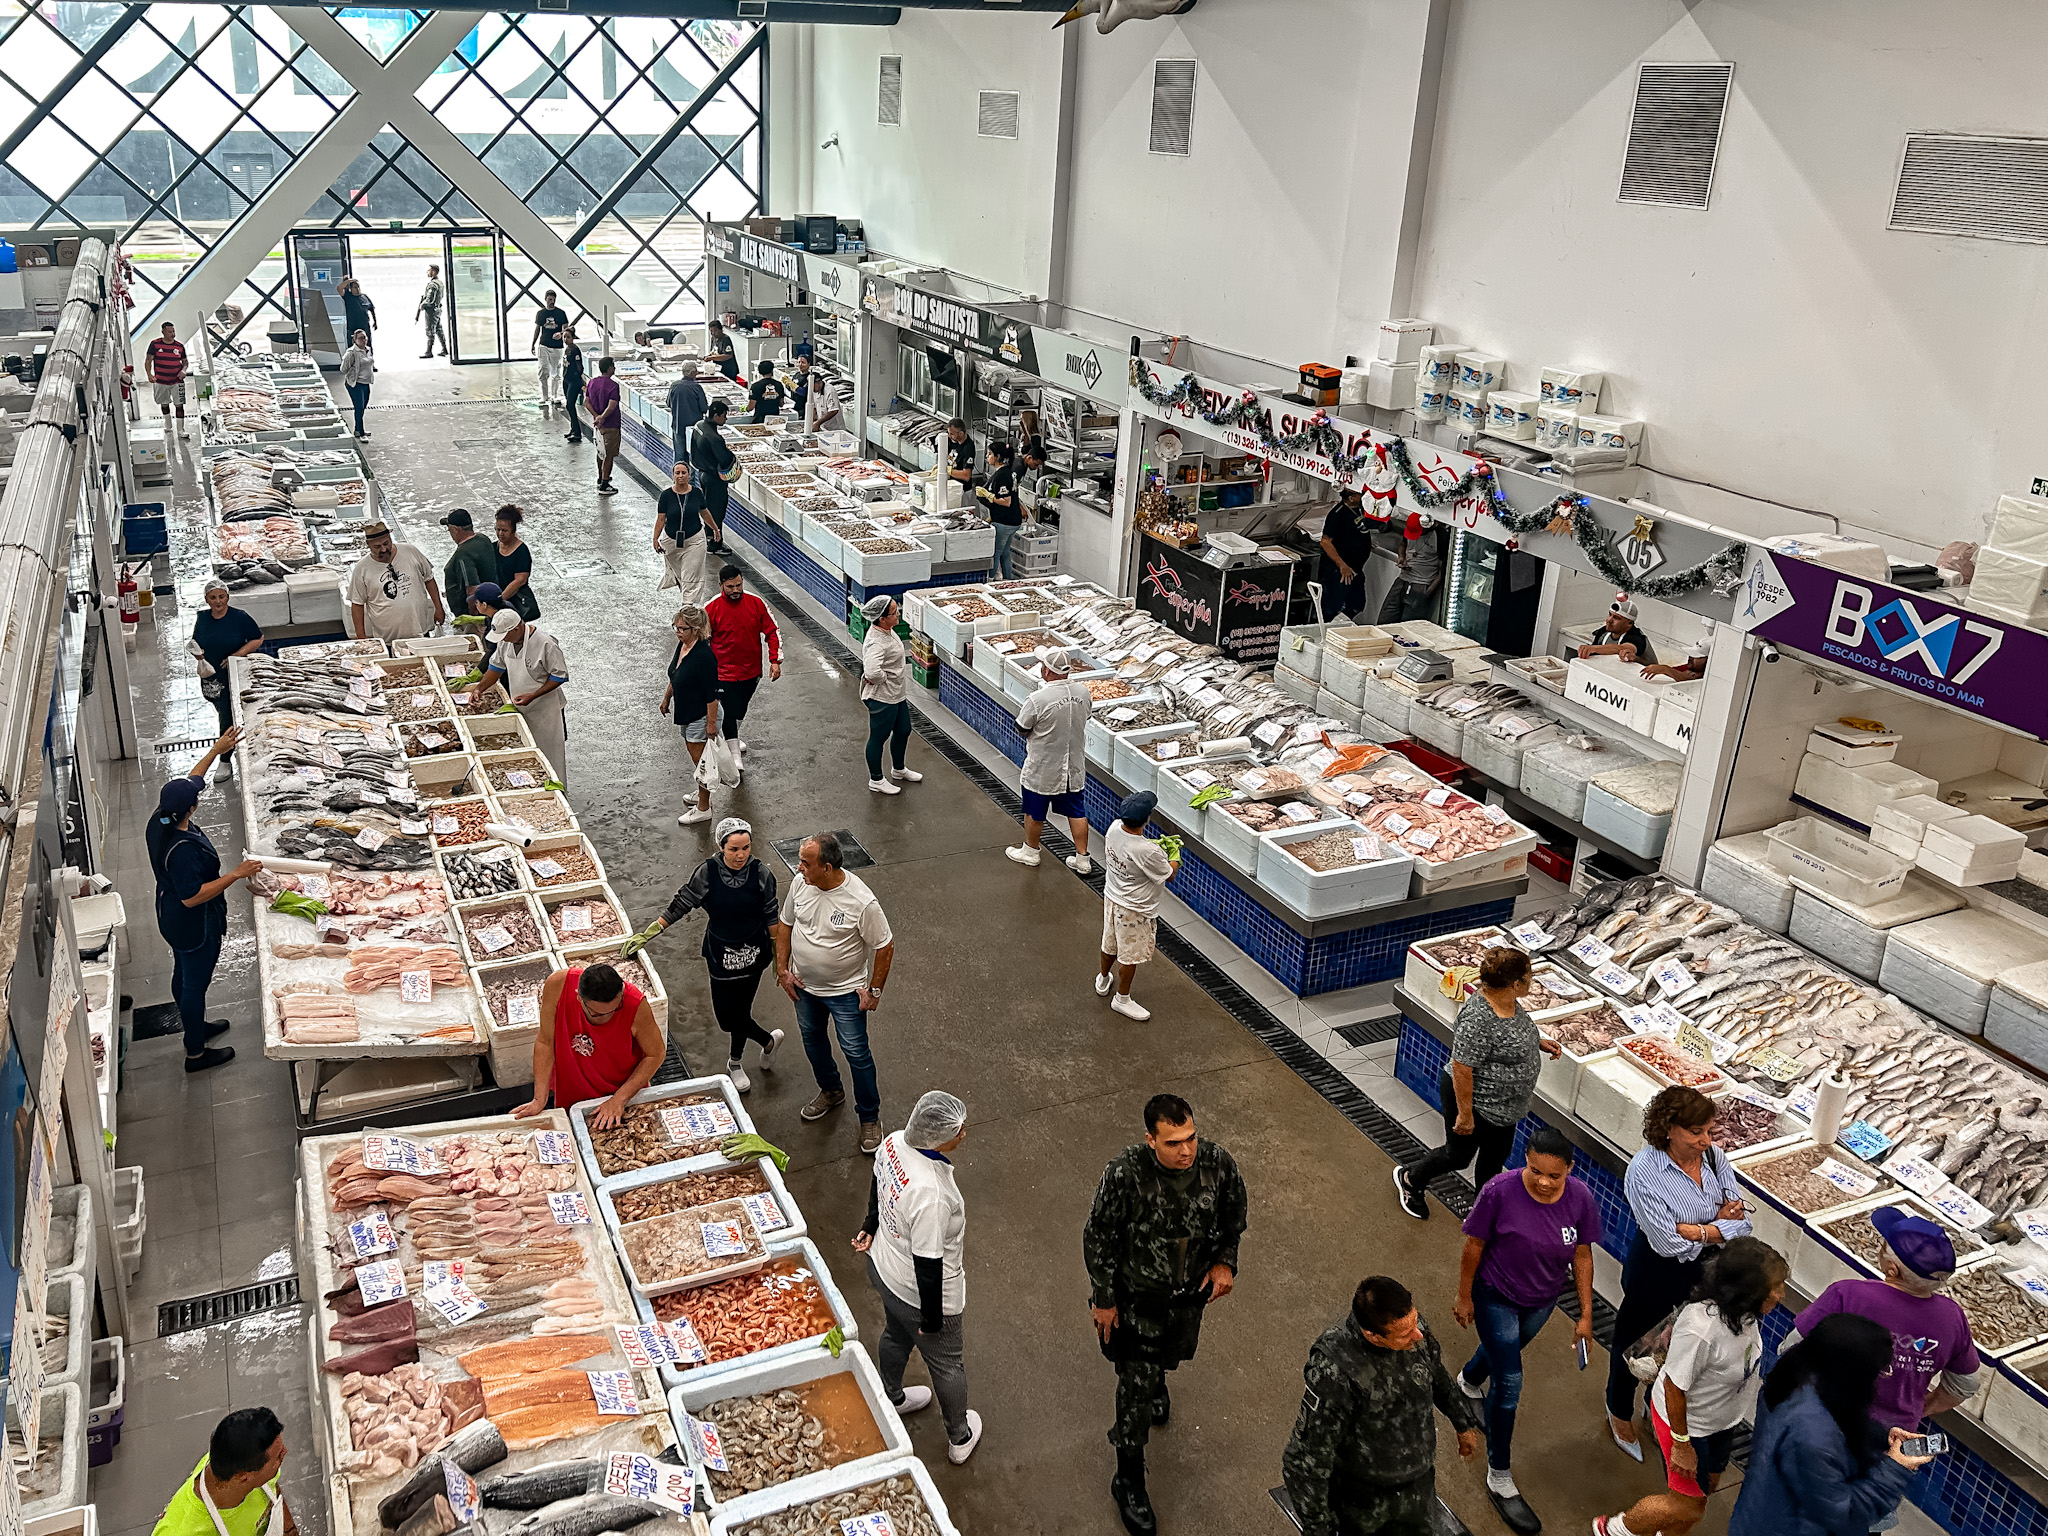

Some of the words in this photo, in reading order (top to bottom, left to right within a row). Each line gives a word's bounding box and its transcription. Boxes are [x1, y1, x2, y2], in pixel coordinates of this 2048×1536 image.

[740, 237, 758, 264] ALEX
[758, 242, 799, 282] SANTISTA
[821, 271, 831, 286] BOX
[894, 283, 913, 315] BOX
[914, 293, 928, 321] DO
[929, 298, 980, 339] SANTISTA
[1066, 353, 1082, 375] BOX
[1086, 360, 1096, 379] 03
[1227, 431, 1241, 446] (13)
[1290, 451, 1305, 469] (13)
[1627, 536, 1653, 569] 05
[1756, 589, 1778, 605] 1982
[1757, 581, 1785, 597] DESDE
[1822, 641, 1878, 673] PESCADOS
[1879, 660, 1889, 673] &
[1890, 666, 1936, 691] FRUTOS
[1937, 682, 1955, 697] DO
[1957, 689, 1985, 708] MAR
[666, 1110, 688, 1138] OFERTA
[368, 1136, 384, 1166] OFERTA
[402, 1141, 420, 1172] PANGA
[885, 1136, 910, 1188] BARRIGUDA
[890, 1184, 900, 1201] BOX
[563, 1195, 579, 1222] TILAPIA
[432, 1297, 466, 1320] FILE
[619, 1329, 647, 1365] OFERTA
[88, 1434, 102, 1445] 23
[607, 1451, 629, 1494] OFERTA
